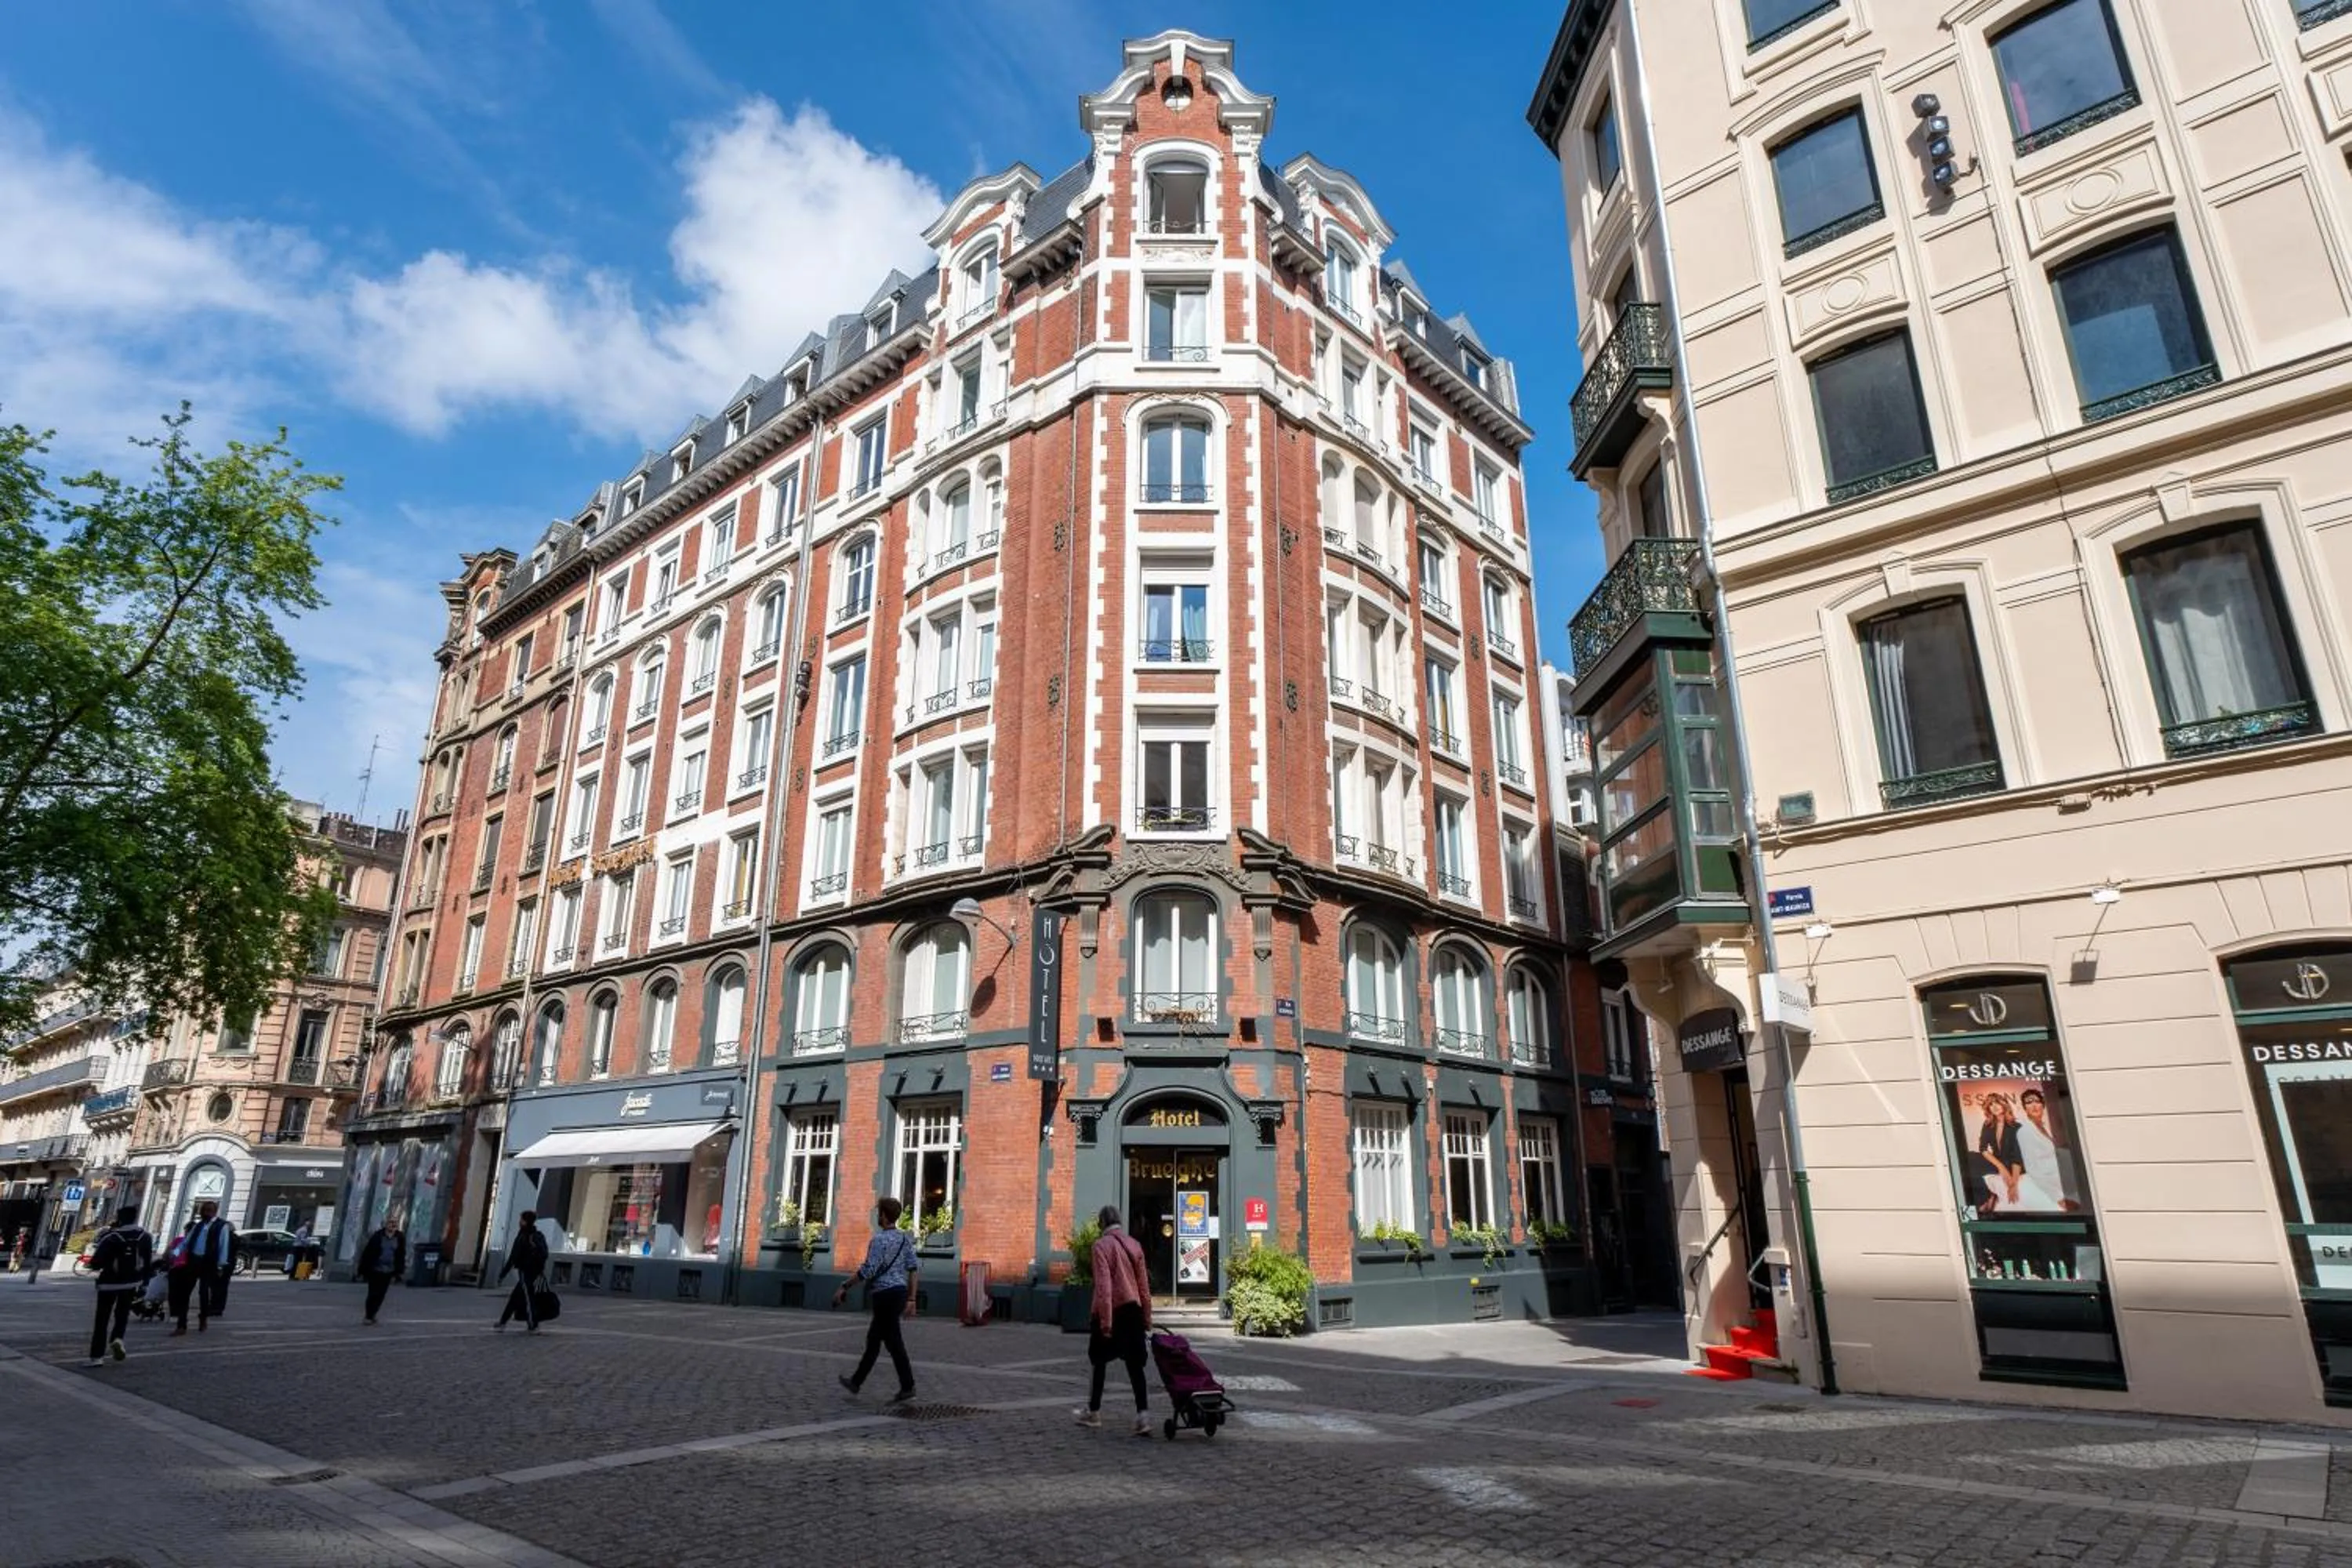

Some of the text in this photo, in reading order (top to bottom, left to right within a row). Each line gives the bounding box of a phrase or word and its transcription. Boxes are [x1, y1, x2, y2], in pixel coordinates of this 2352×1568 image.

[1681, 1026, 1732, 1055] DESSANGE
[1941, 1060, 2056, 1080] DESSANGE
[1150, 1109, 1200, 1127] Hotel
[1130, 1157, 1218, 1185] Brueghe
[1254, 1203, 1264, 1213] H
[2321, 1246, 2352, 1258] DE
